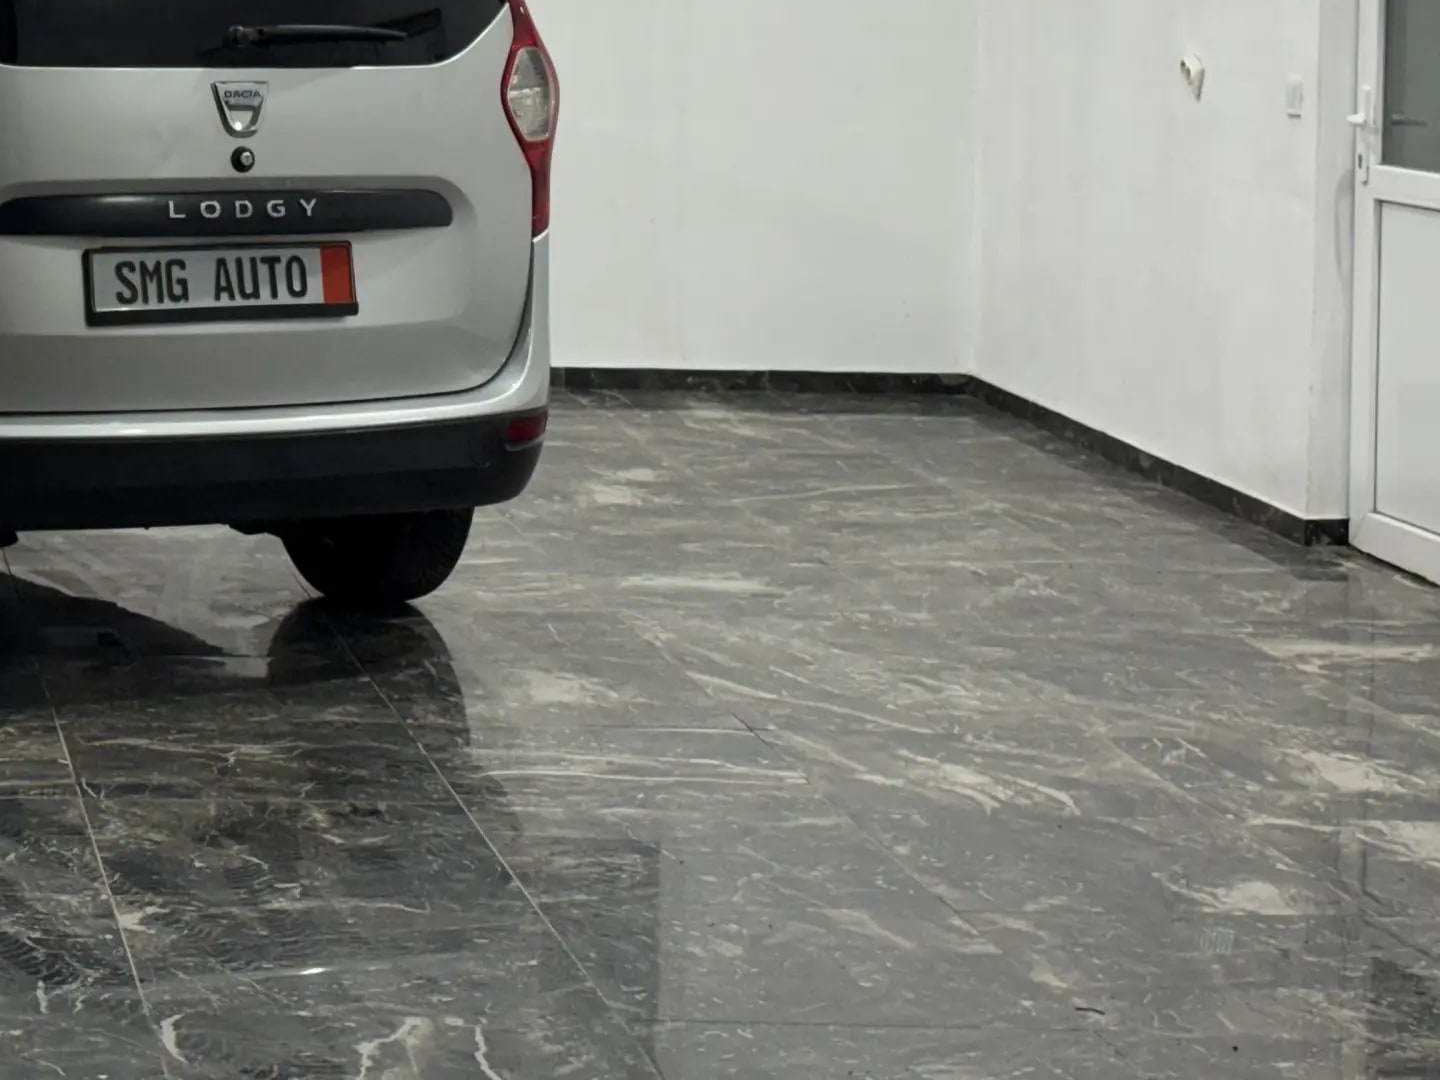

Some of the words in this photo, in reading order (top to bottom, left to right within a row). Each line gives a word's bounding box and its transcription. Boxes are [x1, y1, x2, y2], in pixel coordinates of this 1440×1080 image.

[223, 89, 262, 99] DACIA
[168, 198, 317, 219] LODGY
[113, 258, 190, 305] SMG
[213, 254, 308, 302] AUTO
